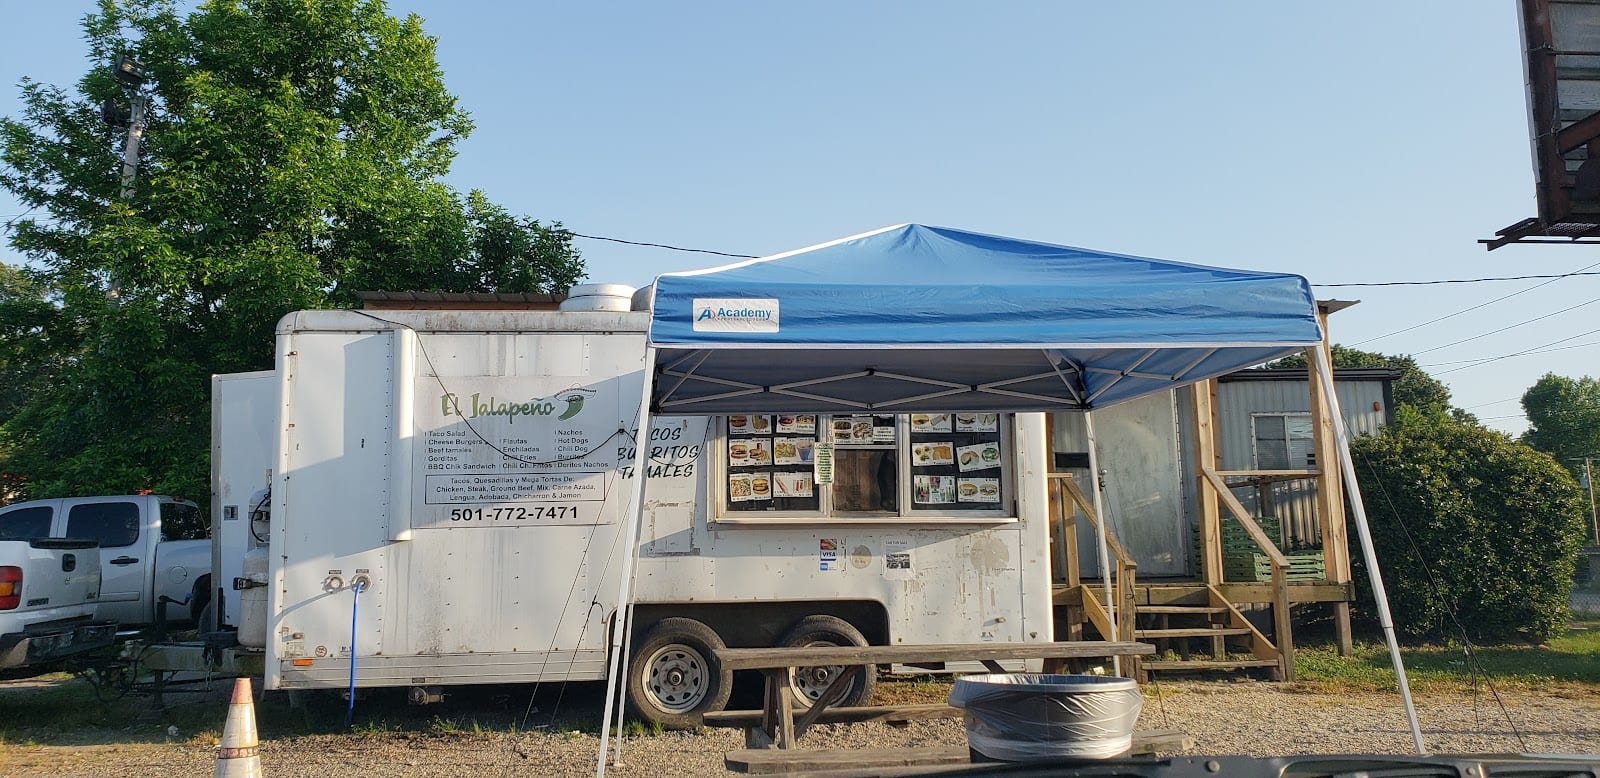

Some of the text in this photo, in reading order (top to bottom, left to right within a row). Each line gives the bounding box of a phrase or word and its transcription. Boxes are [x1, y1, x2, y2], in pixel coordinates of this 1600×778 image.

[717, 308, 771, 320] Academy
[440, 392, 555, 424] El Jalapeño
[632, 427, 682, 442] TCOS
[558, 437, 589, 445] Hot Dogs
[618, 445, 699, 460] BURITOS
[473, 477, 513, 485] Quesadillas
[467, 485, 489, 493] Steak,
[478, 493, 511, 501] Adobada,
[451, 506, 578, 522] 501-772-7471
